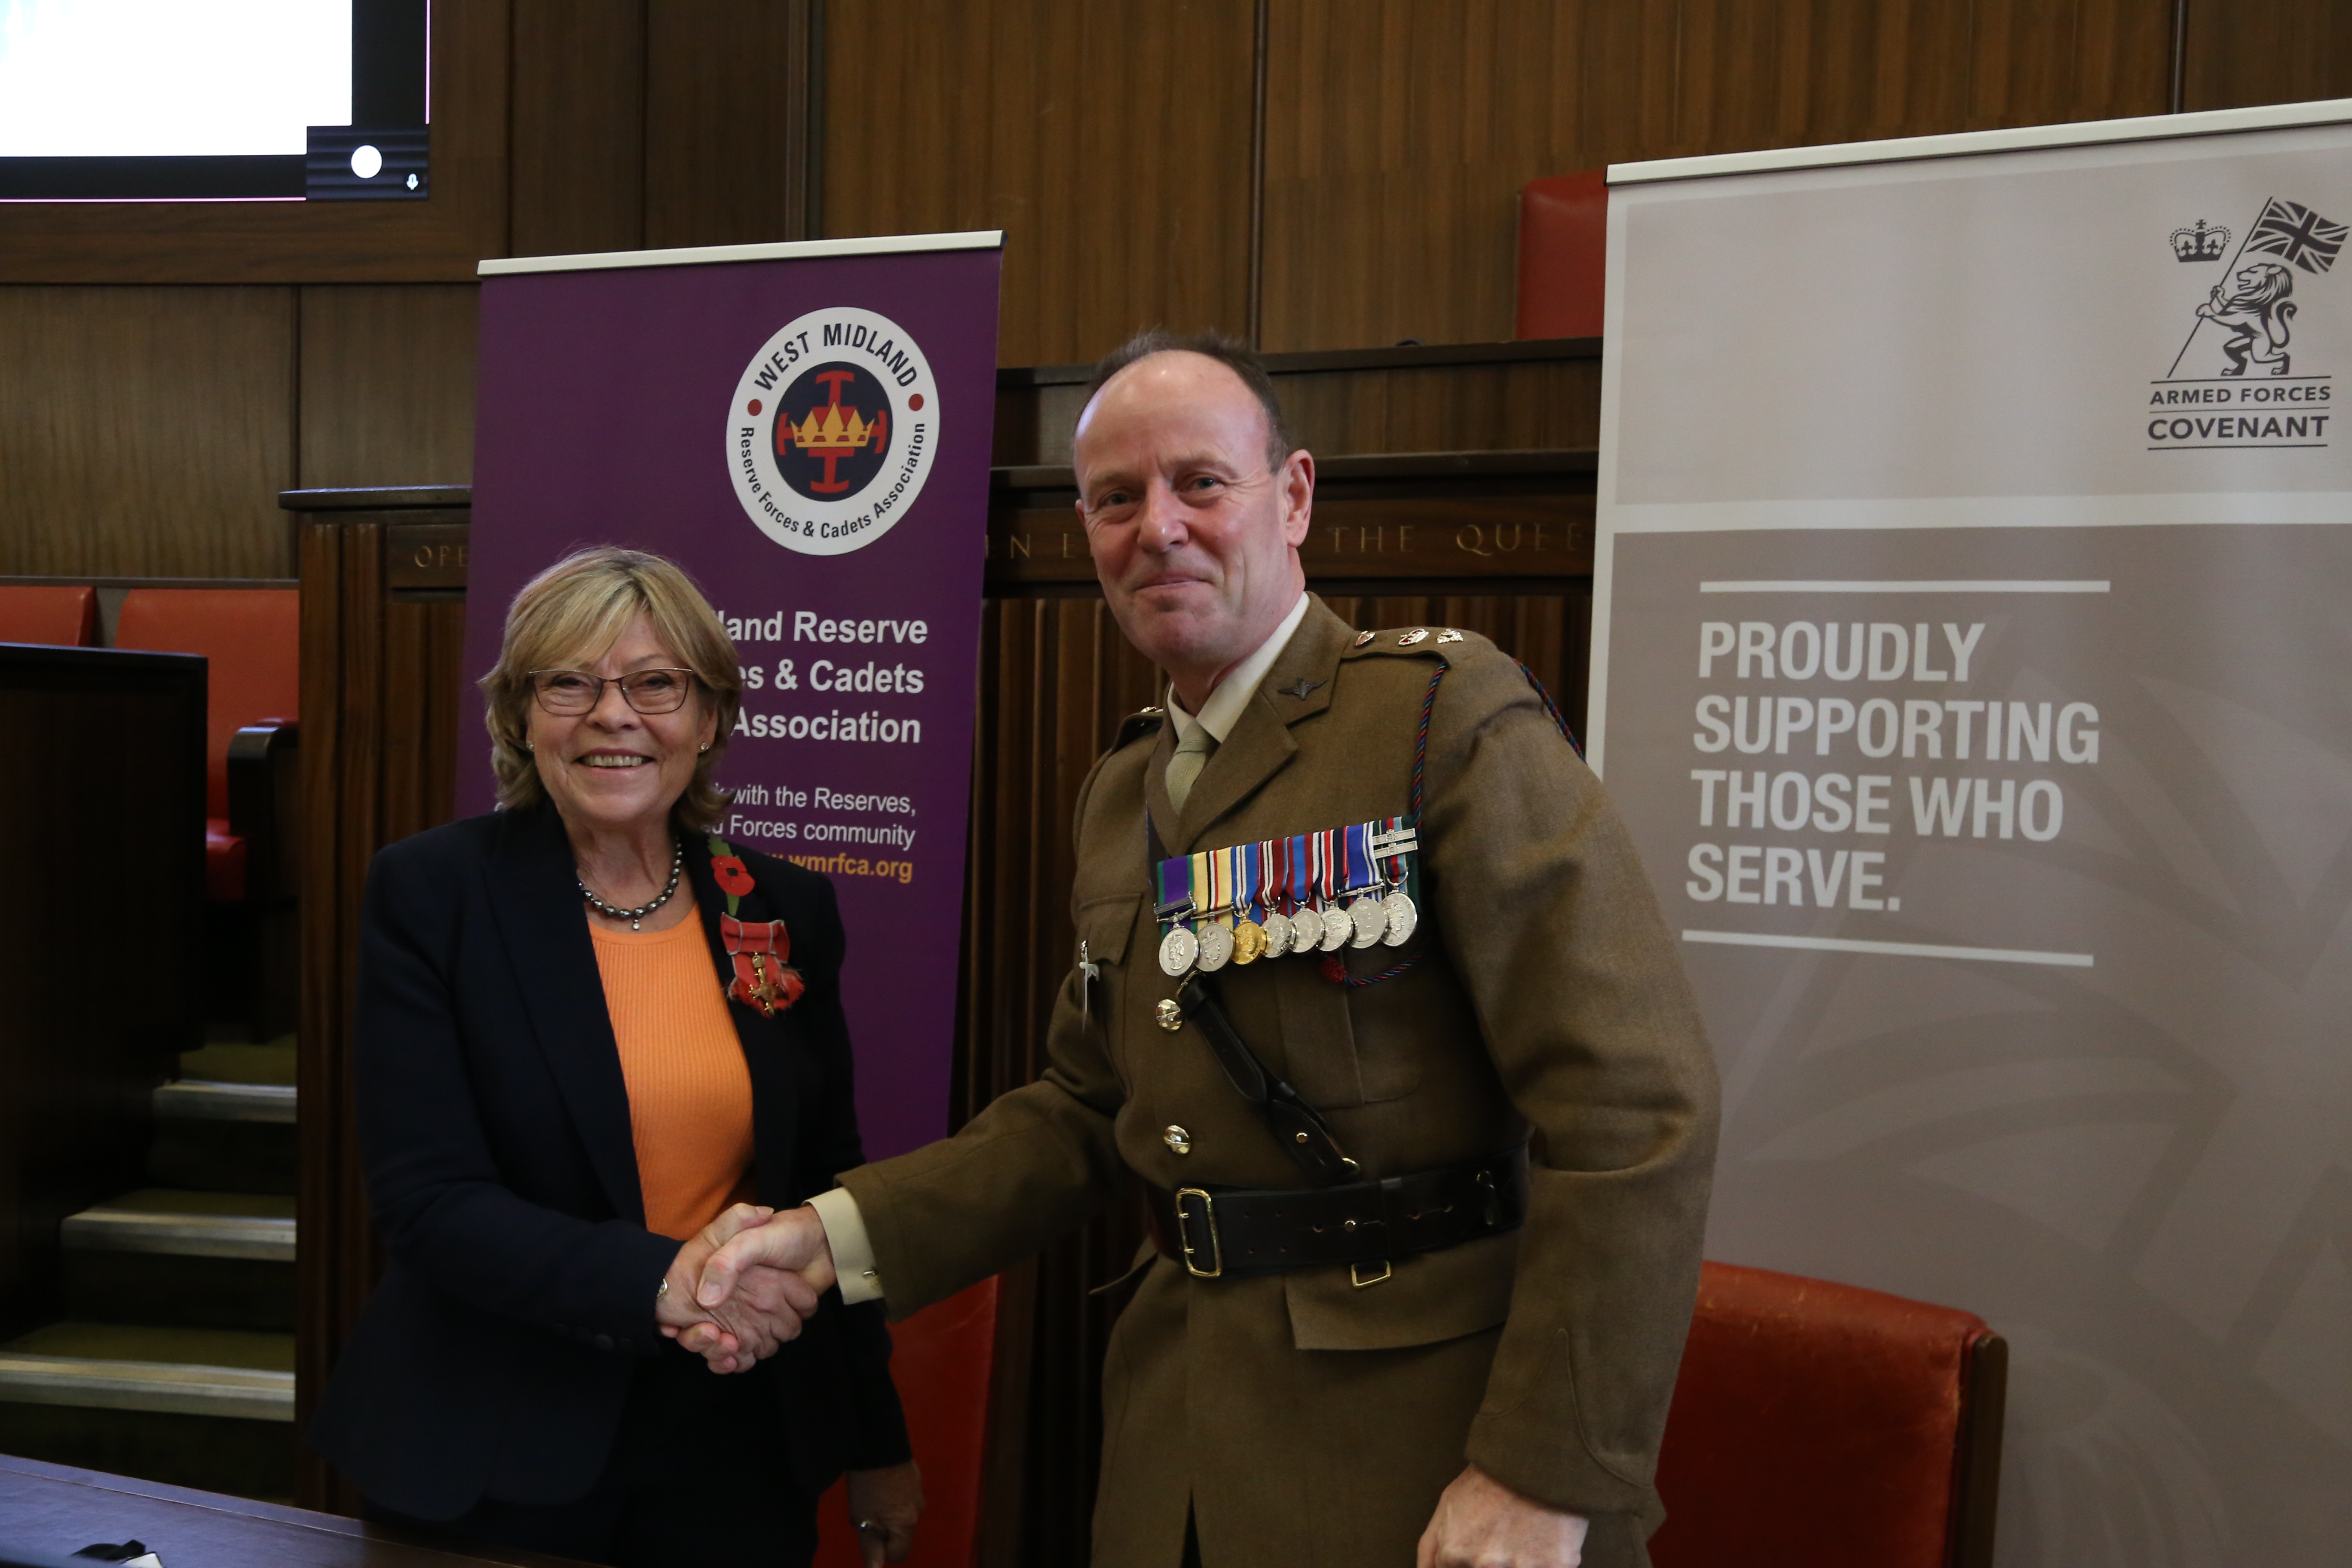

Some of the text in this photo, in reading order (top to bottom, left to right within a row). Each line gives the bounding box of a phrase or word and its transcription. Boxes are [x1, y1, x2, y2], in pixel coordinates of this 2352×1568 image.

[754, 323, 917, 391] WEST MIDLAND
[2150, 386, 2331, 405] ARMED FORCES
[2148, 415, 2329, 440] COVENANT
[741, 423, 925, 538] Reserve Forces & Cadets Association
[1327, 525, 1415, 553] THE
[1456, 522, 1581, 556] QUEE
[793, 611, 928, 644] Reserve
[1698, 621, 1986, 682] PROUDLY
[775, 658, 799, 690] &
[810, 659, 924, 694] Cadets
[731, 706, 921, 743] Association
[1693, 695, 2100, 763] SUPPORTING
[733, 784, 769, 806] with
[775, 785, 807, 808] the
[815, 787, 916, 817] Reserves,
[1691, 769, 2064, 842] THOSE WHO
[731, 815, 797, 839] Forces
[803, 824, 916, 851] community
[1686, 843, 1900, 912] SERVE.
